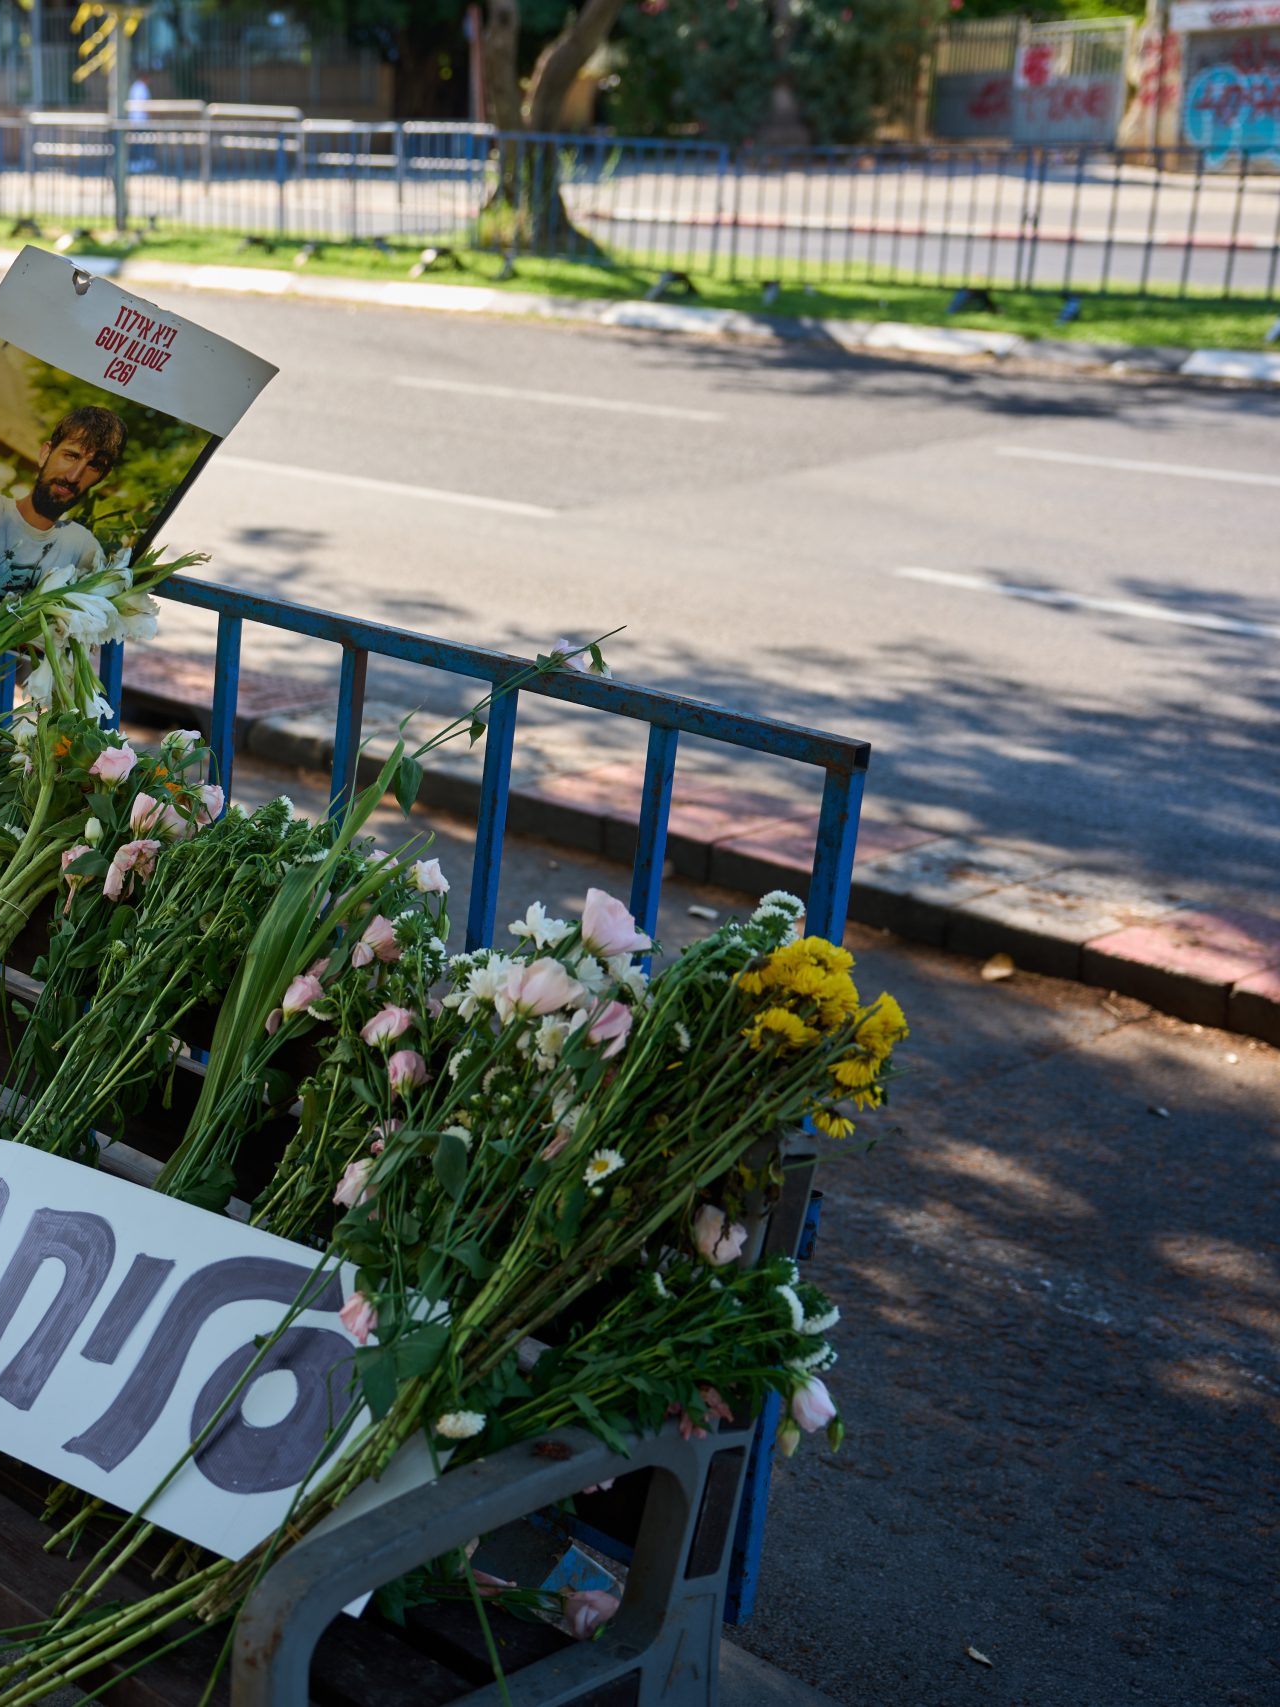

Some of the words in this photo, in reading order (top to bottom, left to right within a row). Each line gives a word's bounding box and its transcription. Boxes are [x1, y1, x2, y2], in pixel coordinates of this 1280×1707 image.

[114, 305, 156, 340] אילוז
[150, 323, 178, 349] גיא
[95, 326, 129, 354] GUY
[123, 340, 171, 372] ILLOUZ
[104, 357, 137, 386] (26)
